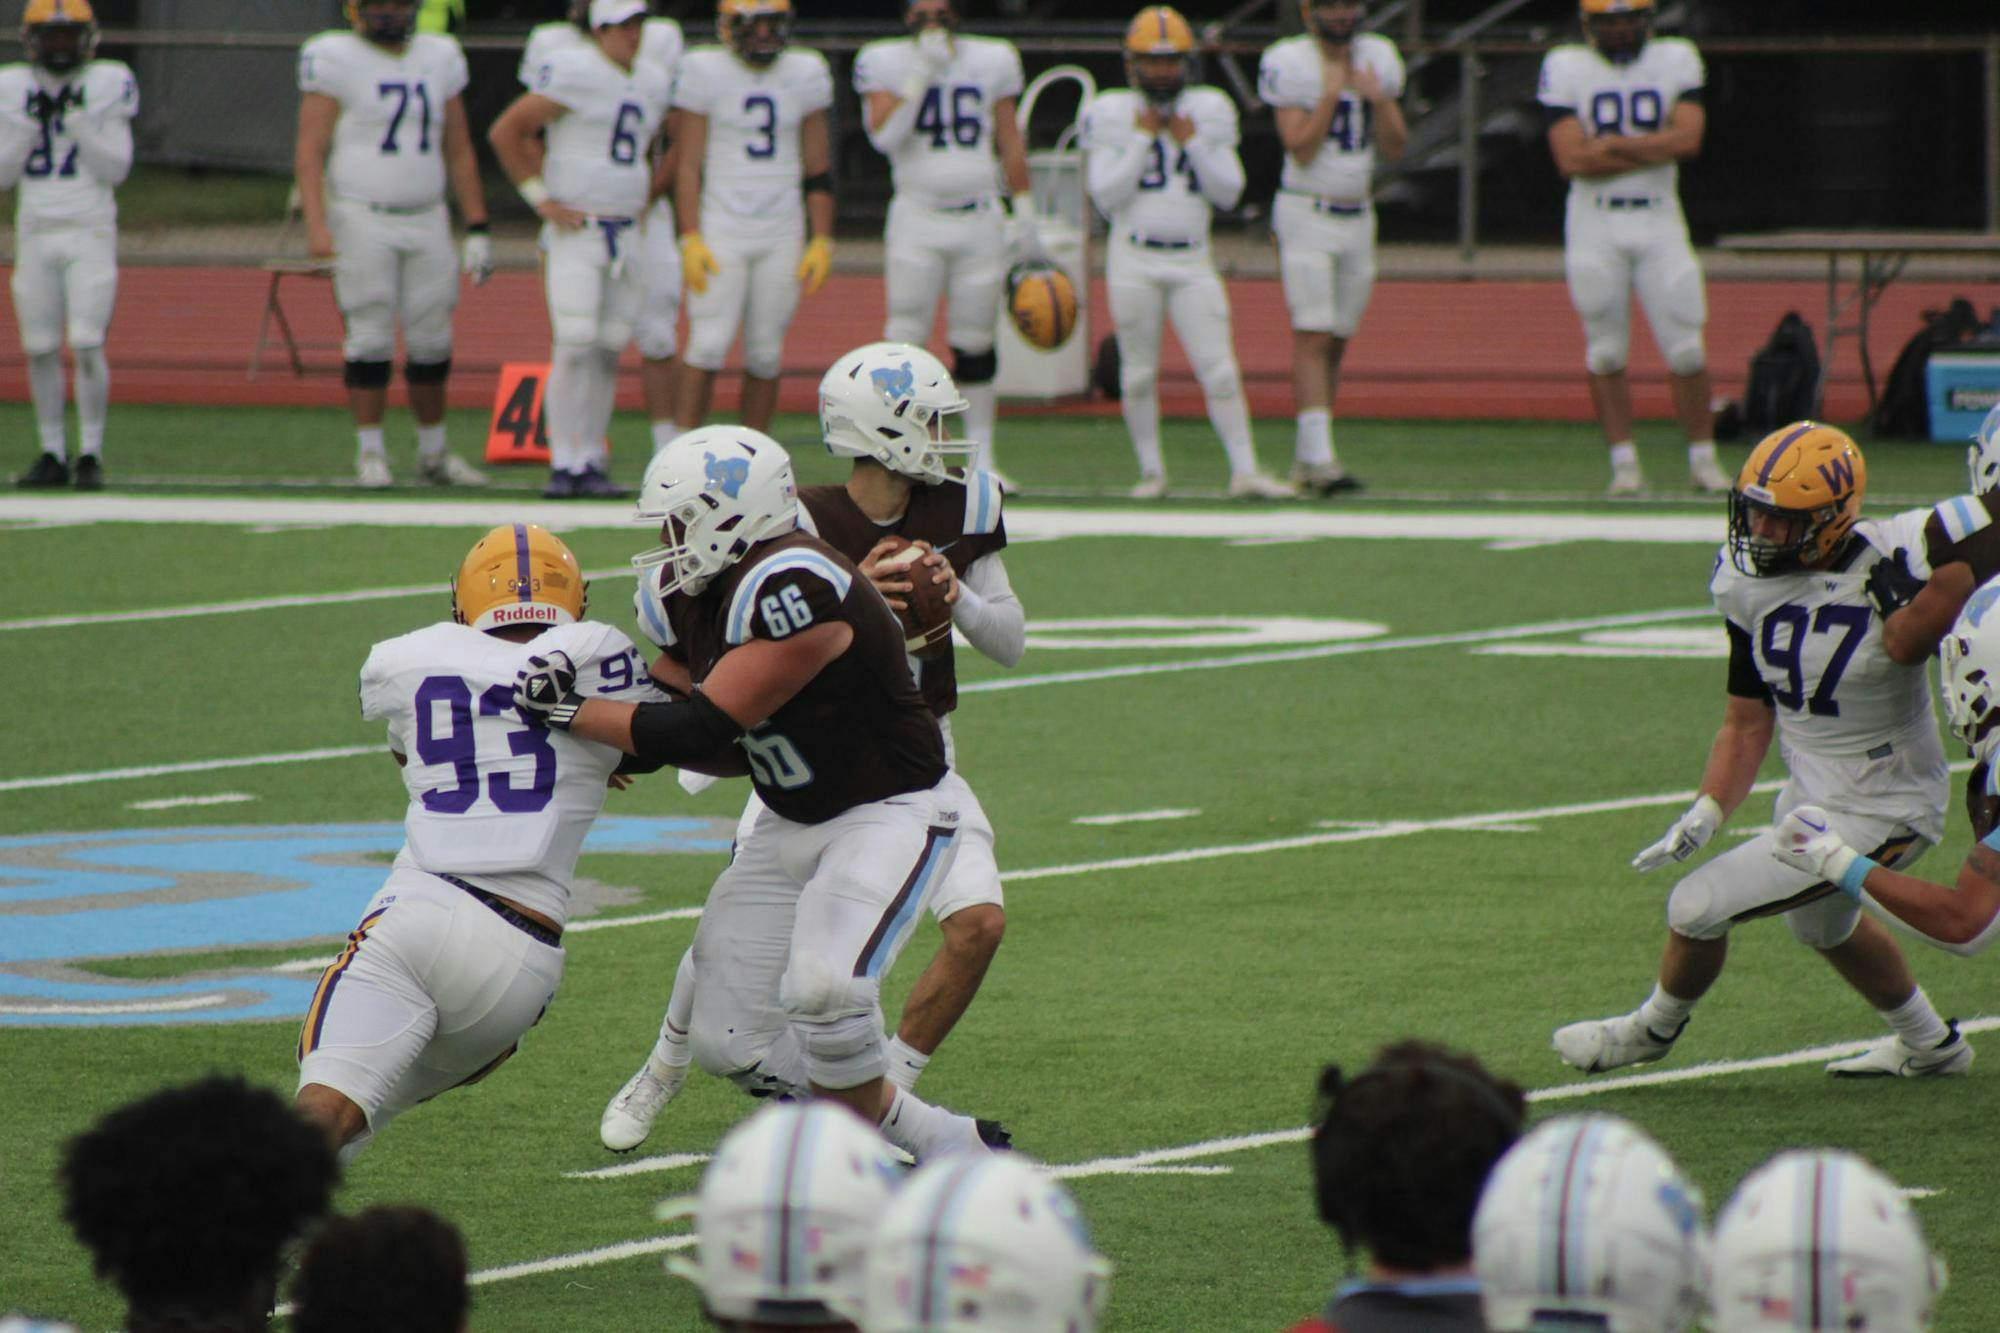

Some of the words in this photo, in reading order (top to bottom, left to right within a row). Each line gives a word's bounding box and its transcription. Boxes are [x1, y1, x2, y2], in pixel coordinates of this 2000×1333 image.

[379, 83, 430, 152] 71
[611, 102, 643, 166] 6
[744, 96, 775, 159] 3
[915, 86, 981, 147] 46
[1816, 451, 1855, 497] W
[493, 607, 557, 623] Riddell
[760, 583, 813, 638] 66
[1824, 580, 1839, 593] W
[1761, 603, 1873, 717] 97
[415, 675, 557, 813] 93
